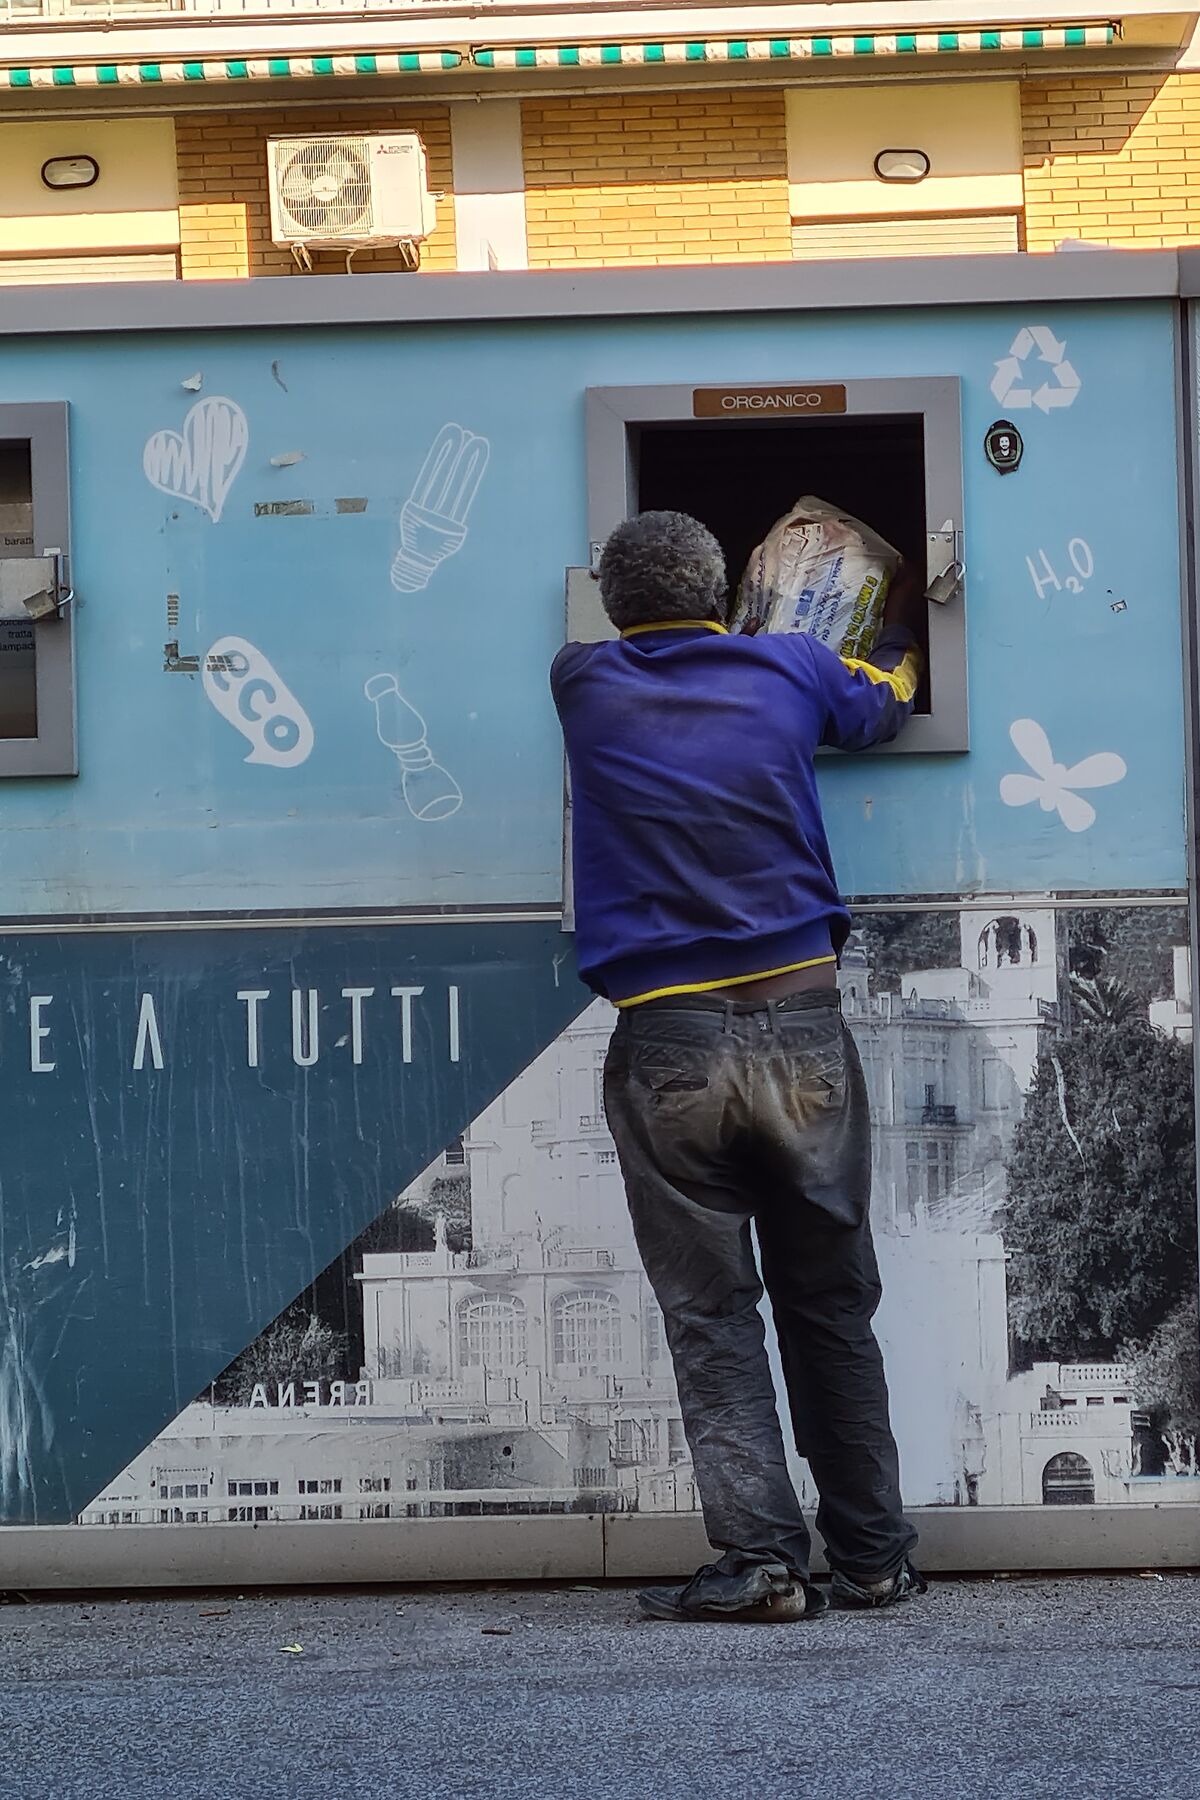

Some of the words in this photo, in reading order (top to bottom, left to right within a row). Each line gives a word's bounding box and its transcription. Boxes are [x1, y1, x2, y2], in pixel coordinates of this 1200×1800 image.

[721, 393, 822, 409] ORGANICO
[30, 995, 56, 1072] E
[237, 986, 459, 1067] TUTTI
